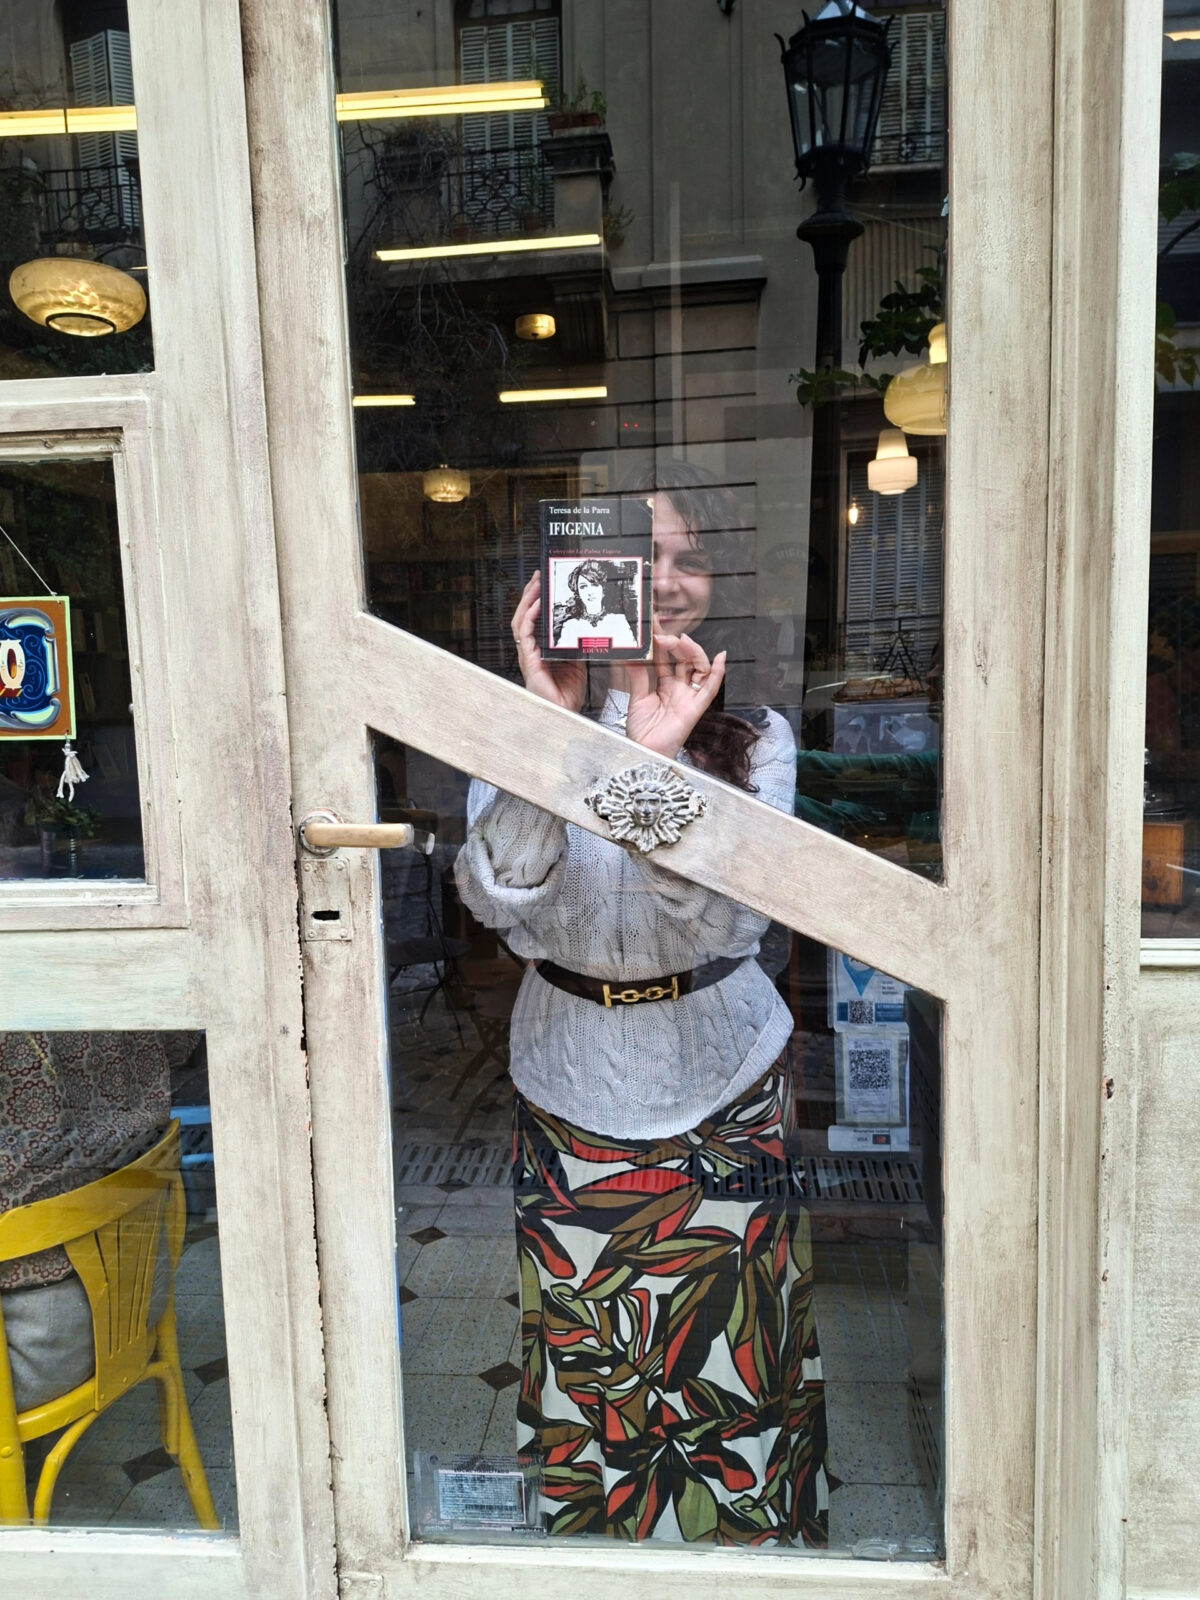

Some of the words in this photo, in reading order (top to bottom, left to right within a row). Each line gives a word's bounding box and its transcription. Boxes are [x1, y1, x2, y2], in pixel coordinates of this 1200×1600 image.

[548, 506, 572, 514] Teresa
[572, 506, 582, 514] de
[583, 506, 590, 514] la
[591, 506, 610, 514] Parra
[549, 522, 604, 536] IFIGENIA
